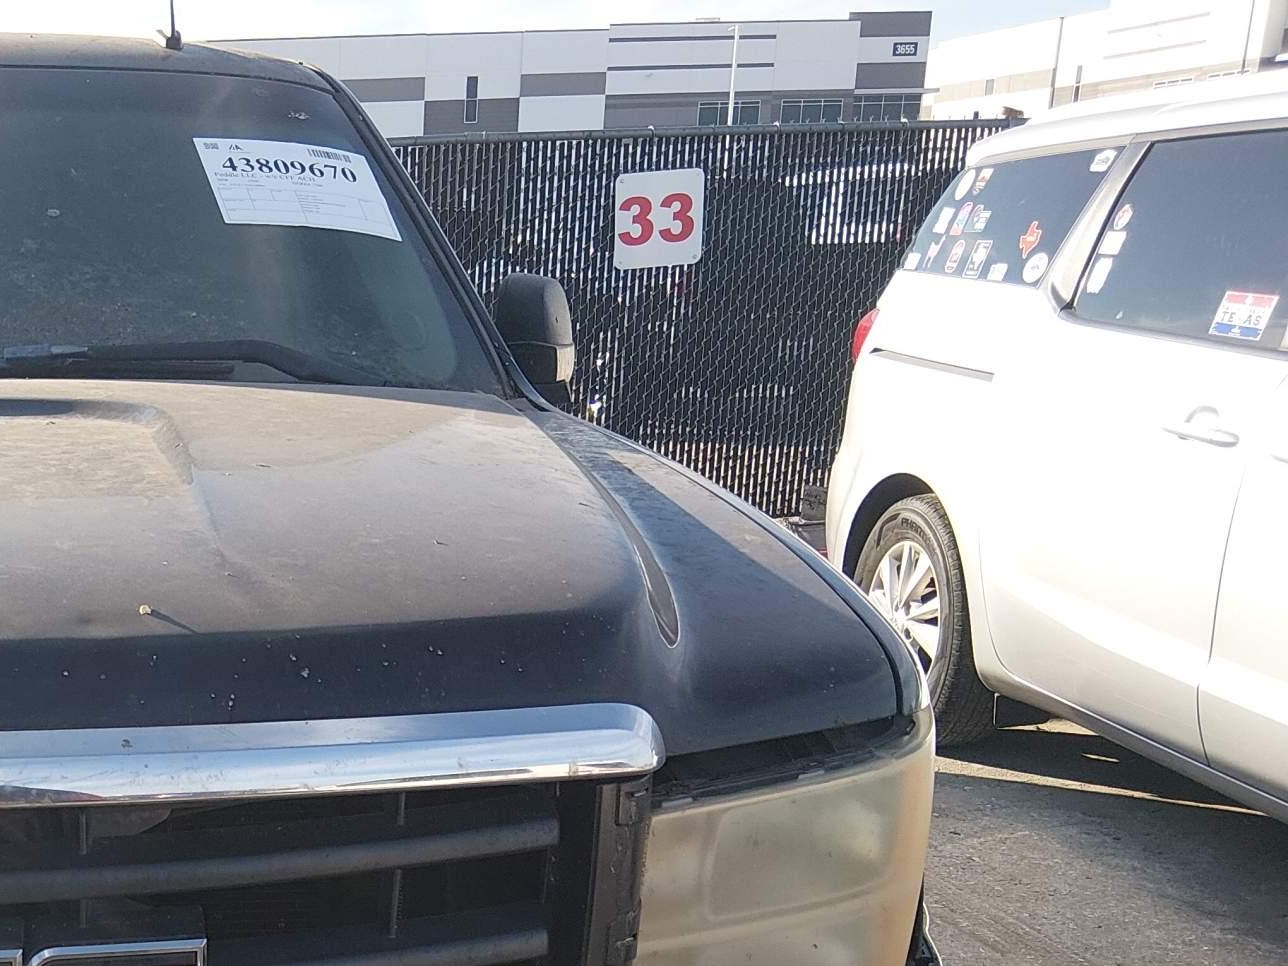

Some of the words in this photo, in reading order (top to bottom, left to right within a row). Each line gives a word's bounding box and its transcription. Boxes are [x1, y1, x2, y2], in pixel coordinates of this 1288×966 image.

[895, 44, 916, 55] 3655
[222, 157, 357, 183] 43809670
[618, 193, 695, 246] 33
[1220, 311, 1263, 326] TEAS
